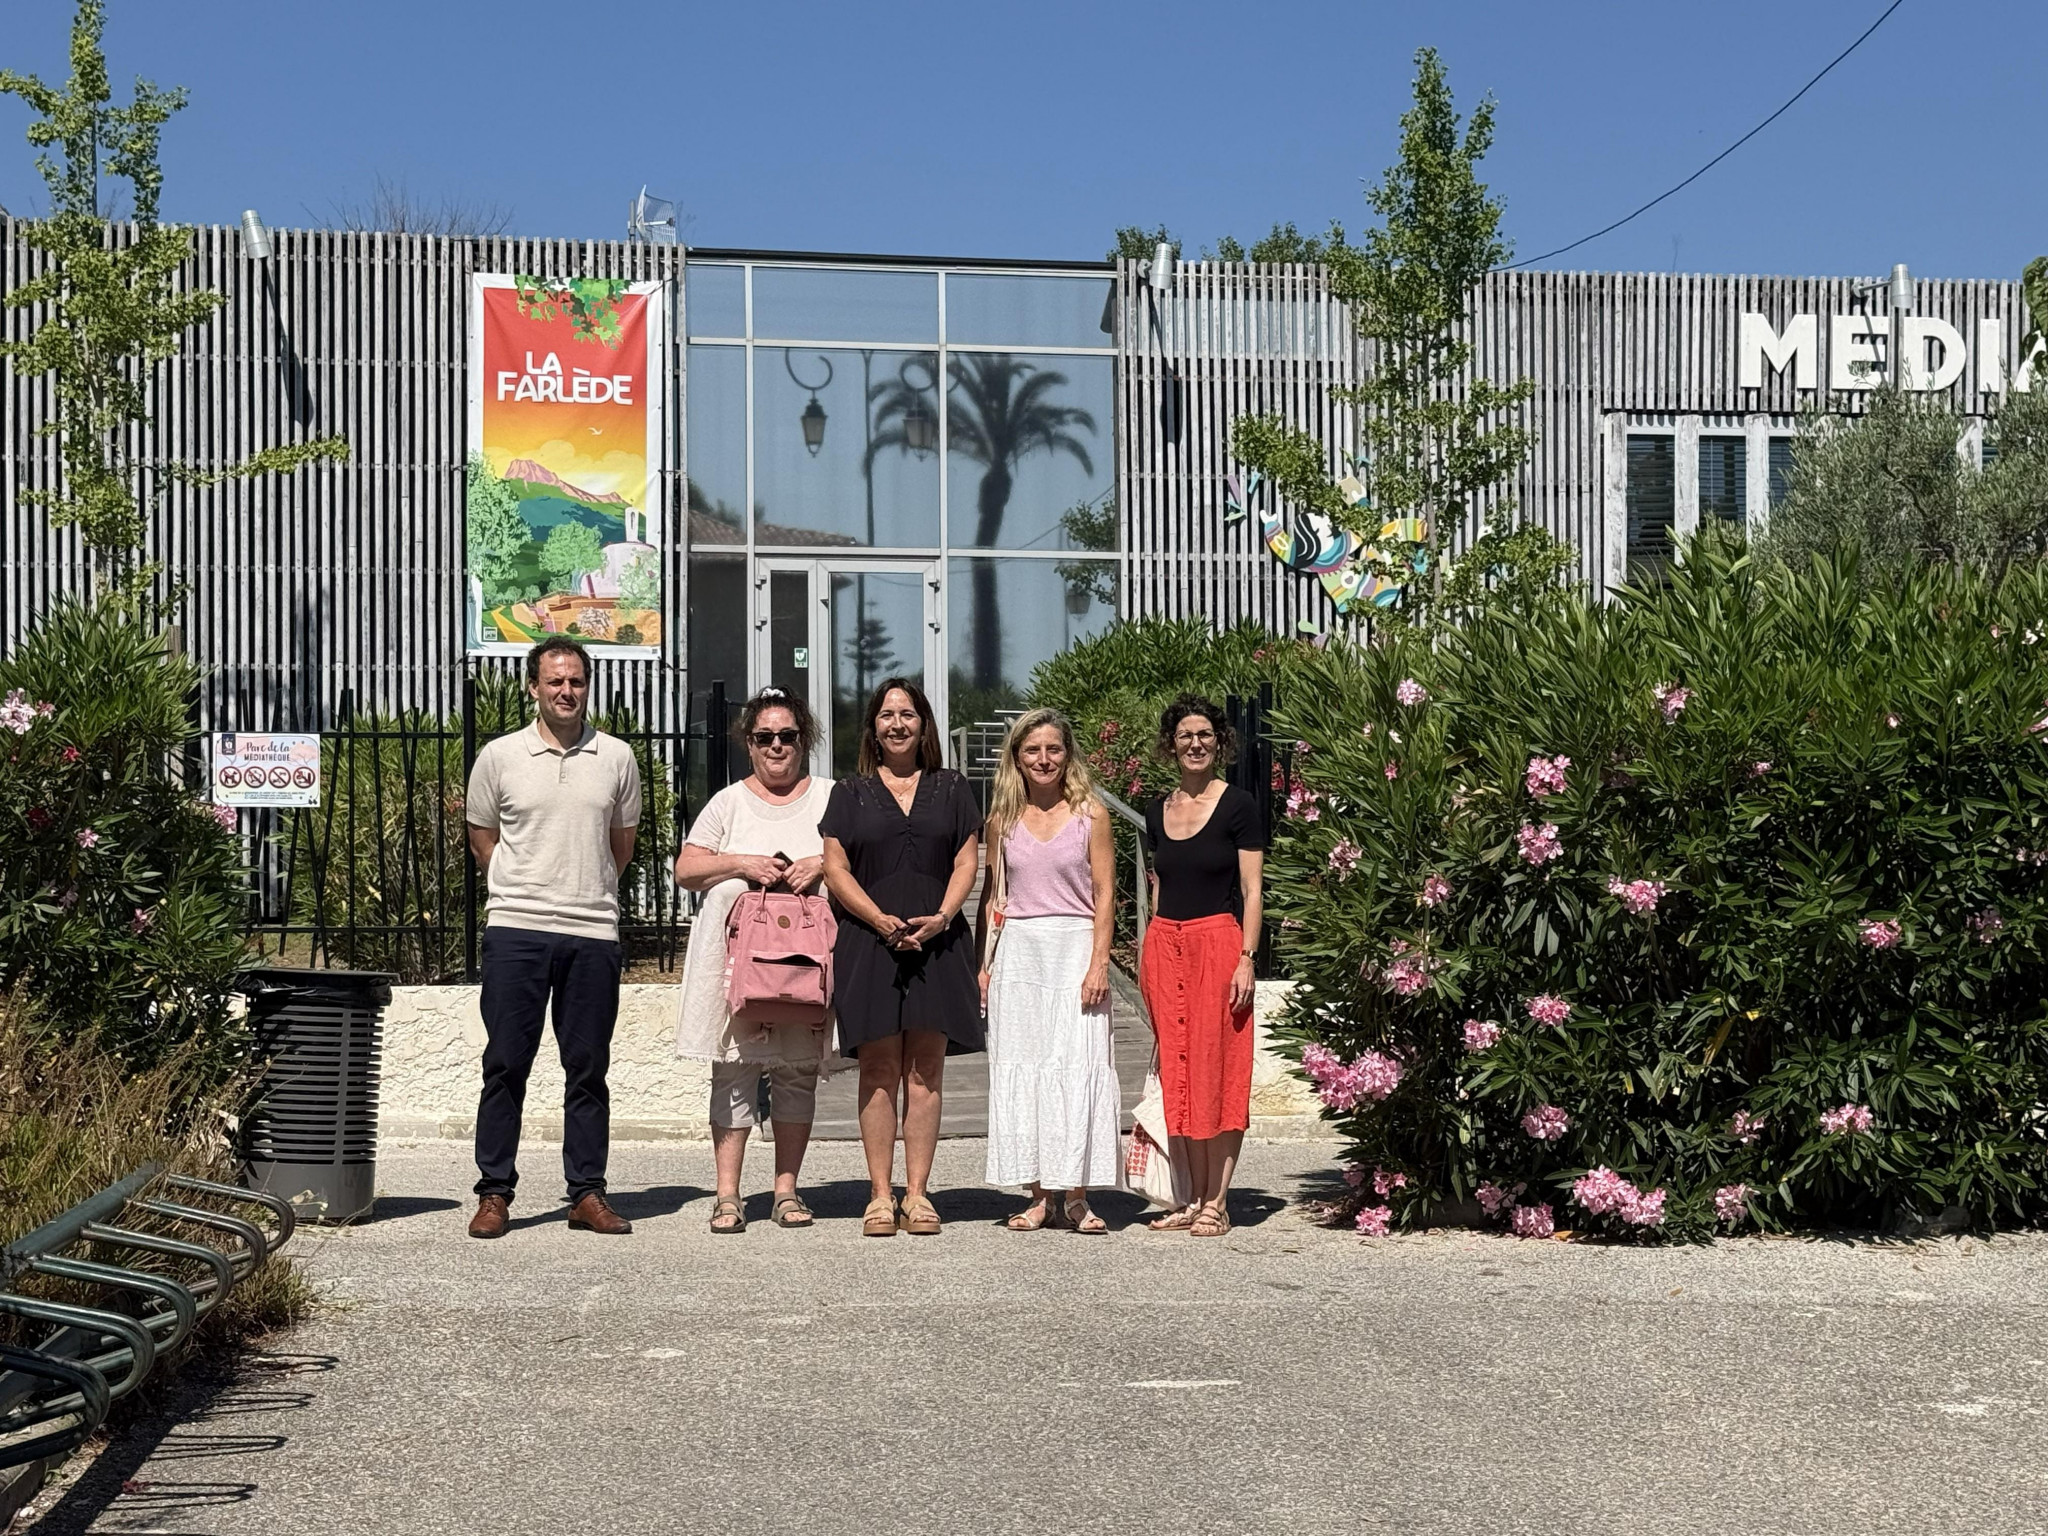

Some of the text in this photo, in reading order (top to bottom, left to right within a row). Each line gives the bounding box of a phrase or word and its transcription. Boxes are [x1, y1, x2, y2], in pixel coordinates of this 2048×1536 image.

[525, 351, 563, 375] LA
[497, 367, 633, 405] FARLÈDE
[247, 741, 266, 752] Parc
[267, 741, 279, 752] de
[280, 742, 290, 752] la
